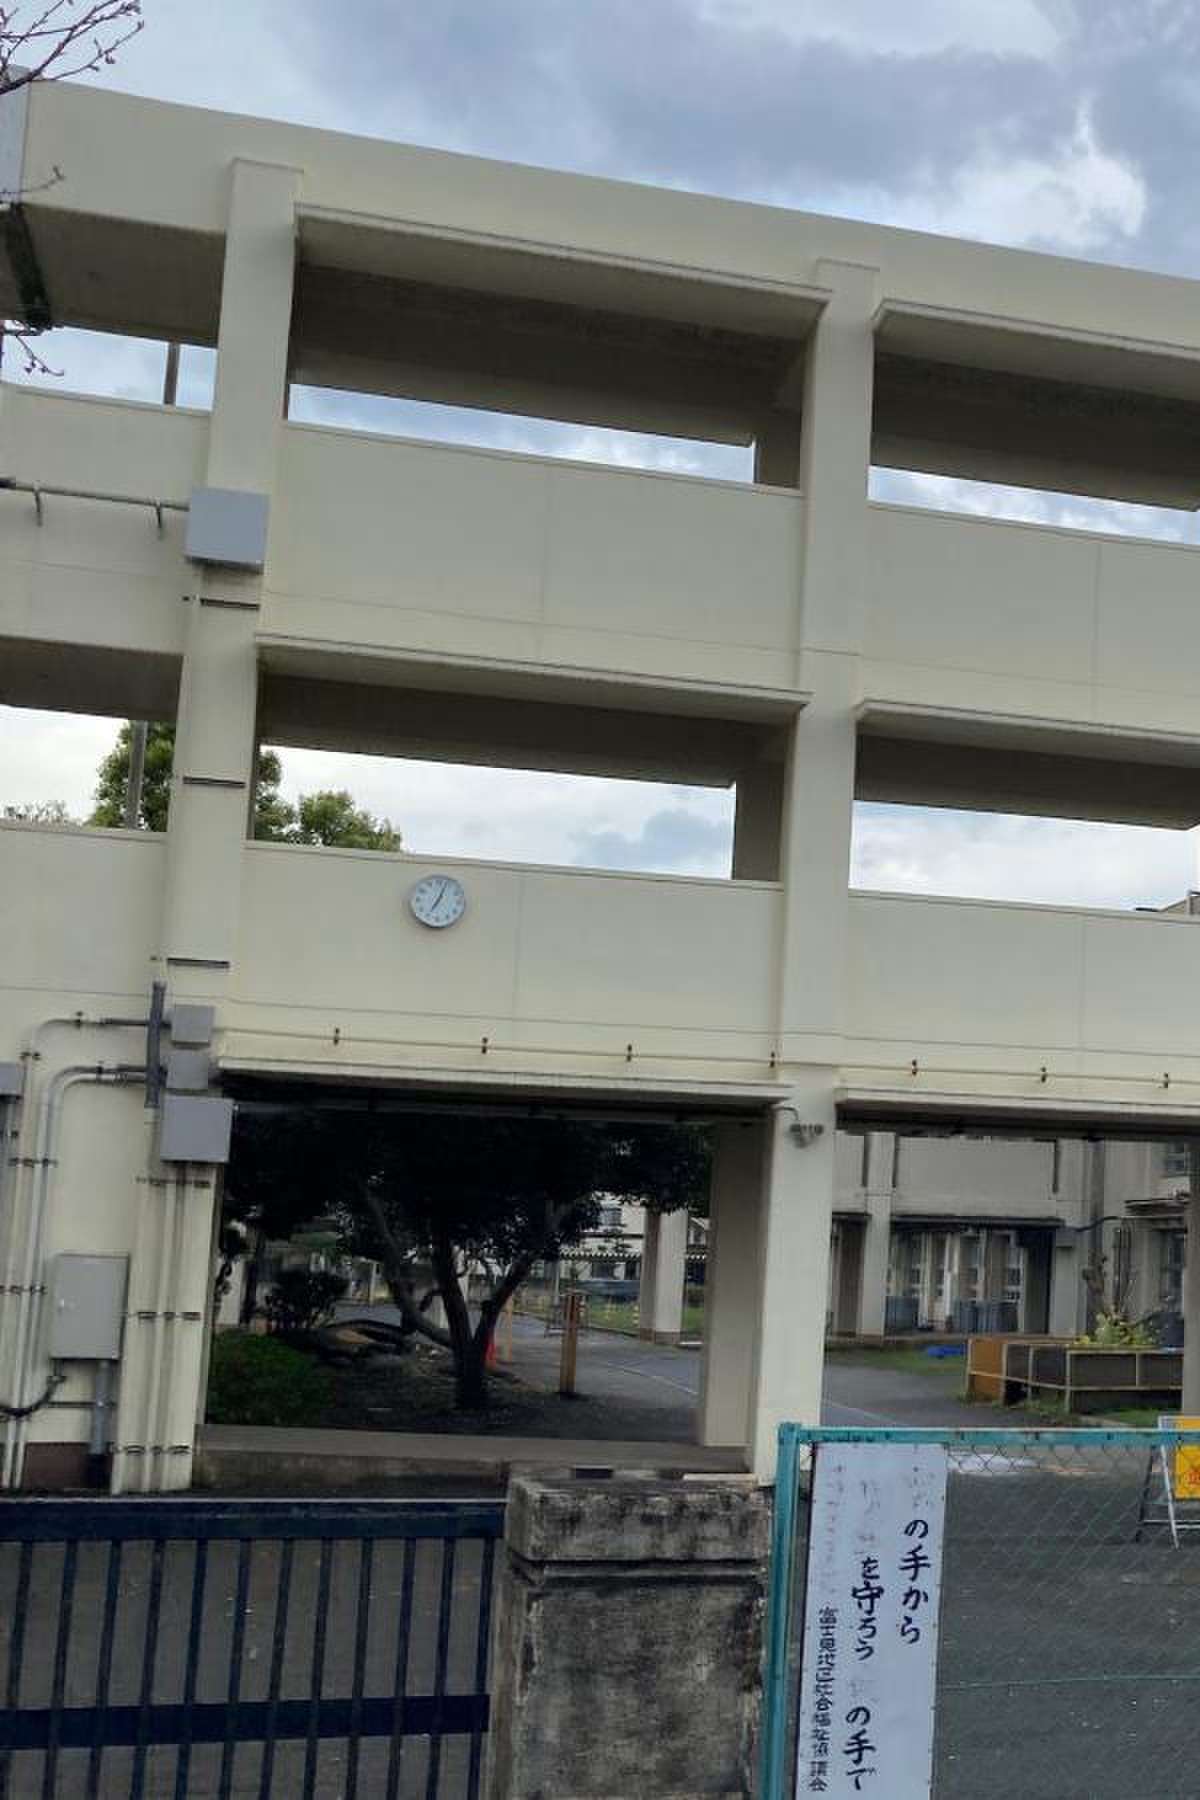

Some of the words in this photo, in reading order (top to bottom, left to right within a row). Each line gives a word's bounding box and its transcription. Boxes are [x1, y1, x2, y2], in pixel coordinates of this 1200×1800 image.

[851, 1556, 885, 1661] を守ろう
[897, 1518, 931, 1644] の手から
[842, 1705, 877, 1791] の手で
